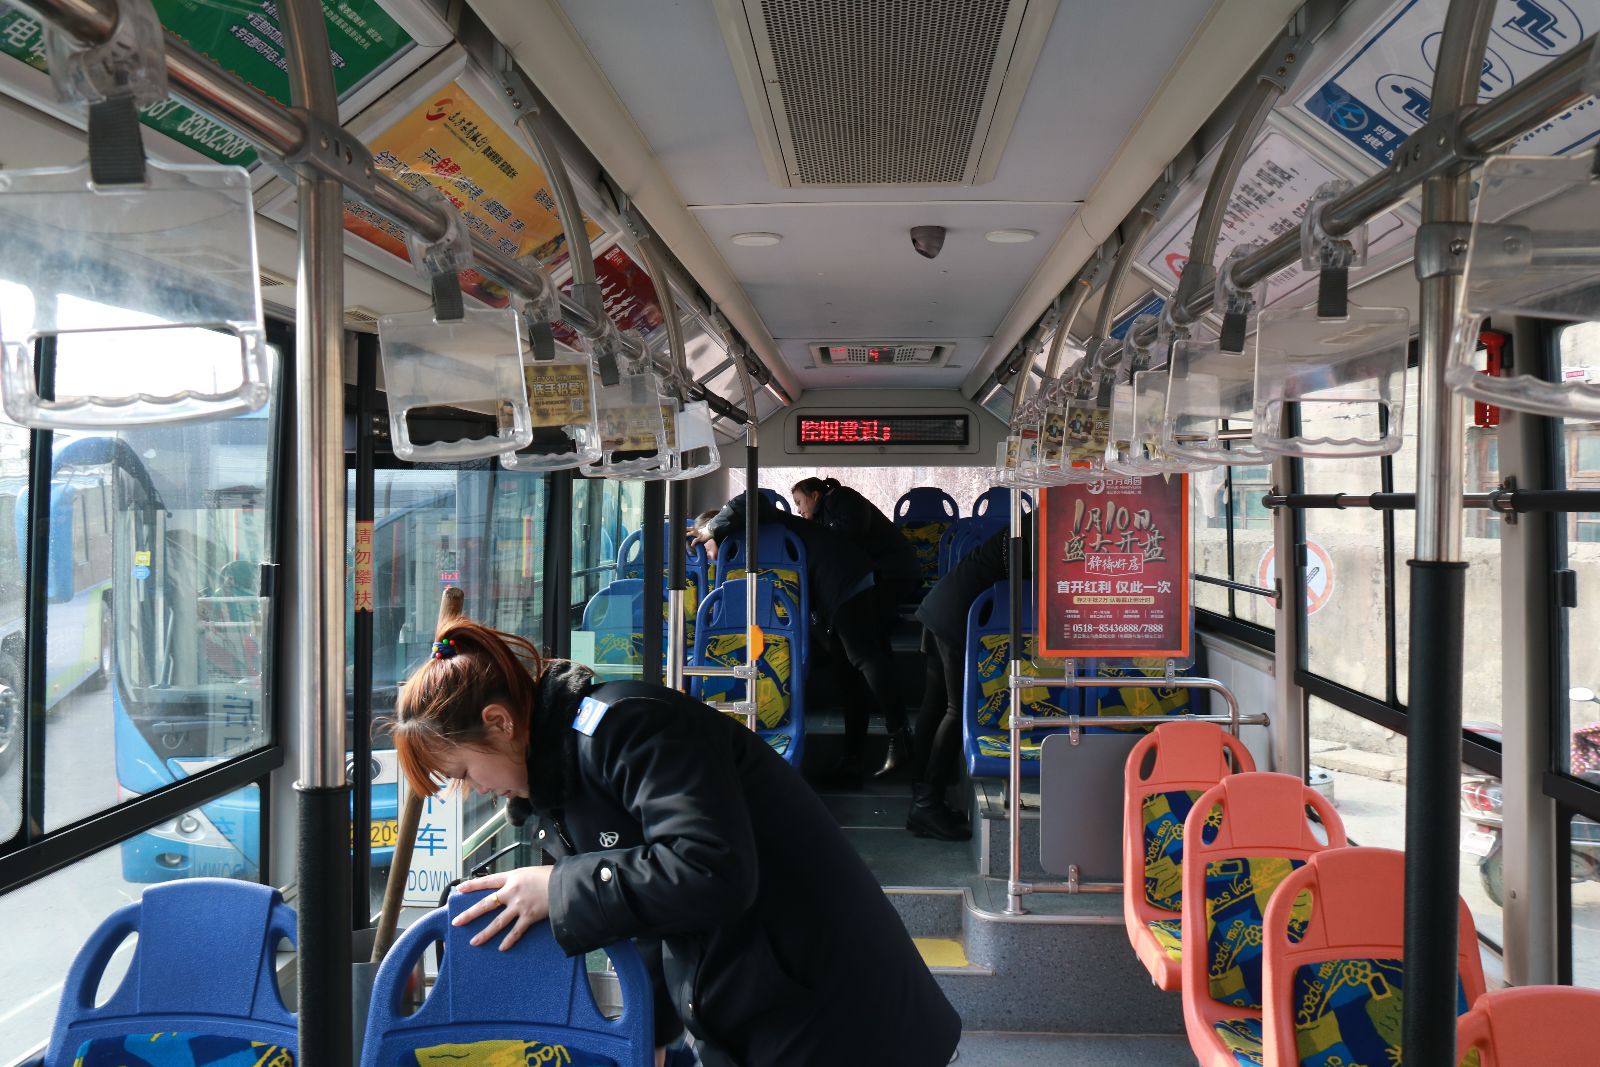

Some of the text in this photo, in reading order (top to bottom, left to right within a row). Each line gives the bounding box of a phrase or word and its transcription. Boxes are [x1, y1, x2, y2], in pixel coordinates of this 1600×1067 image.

[1056, 580, 1171, 594] 首开红利 仅此一次
[408, 869, 452, 892] DOWN
